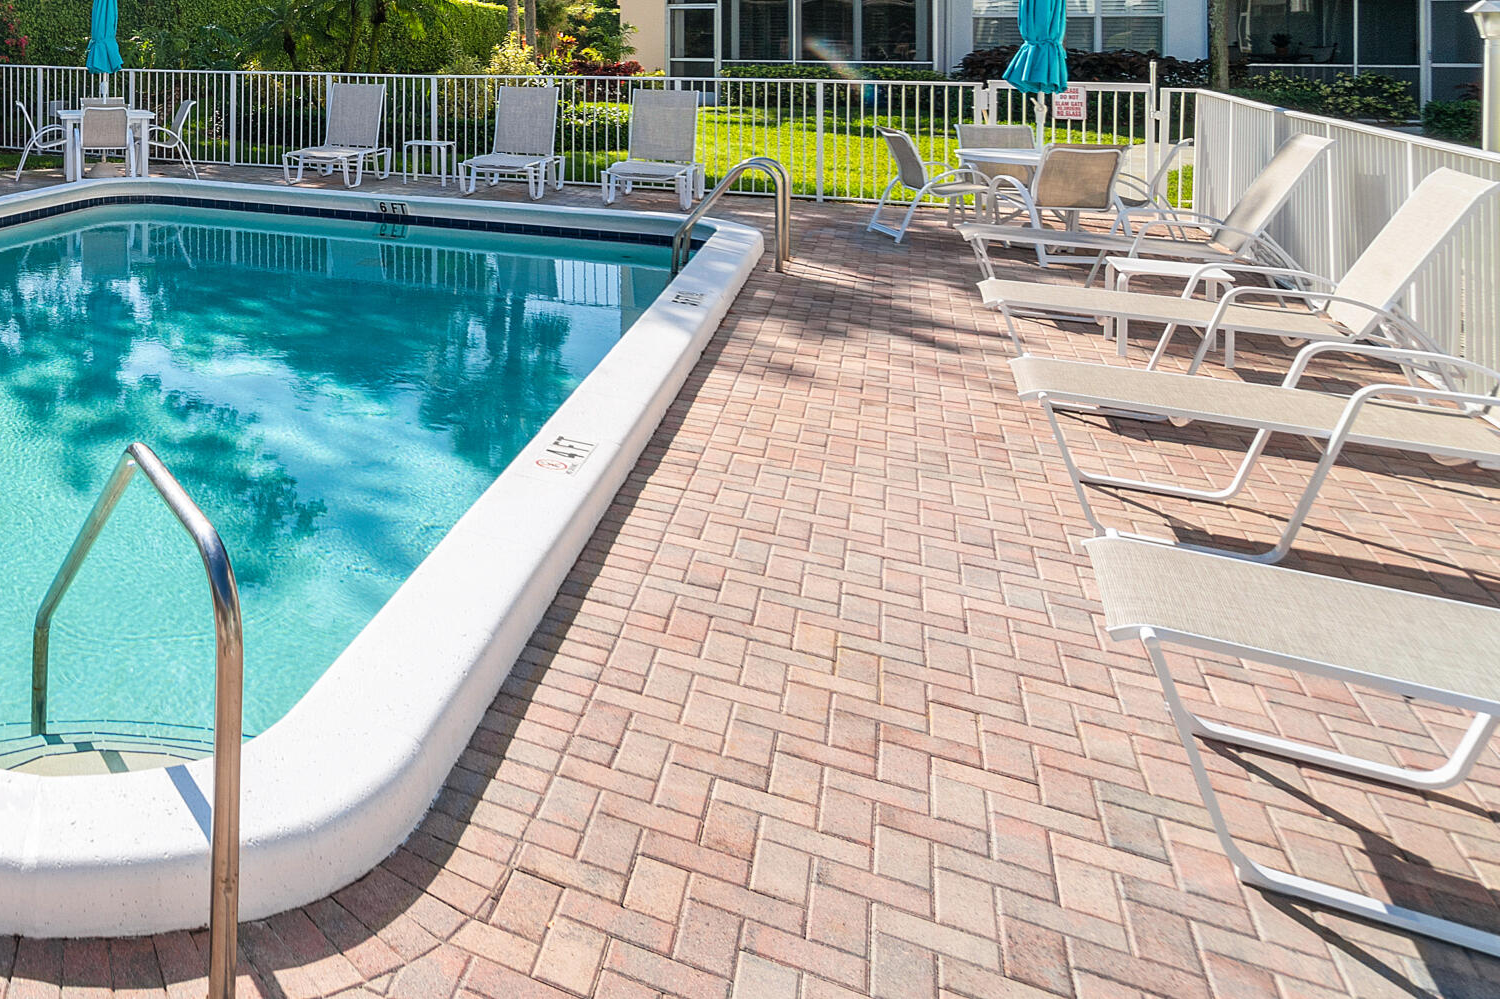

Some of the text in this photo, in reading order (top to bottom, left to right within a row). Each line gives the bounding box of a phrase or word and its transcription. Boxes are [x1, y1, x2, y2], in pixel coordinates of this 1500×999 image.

[379, 202, 406, 214] 6 FT
[546, 435, 595, 459] 4 FT
